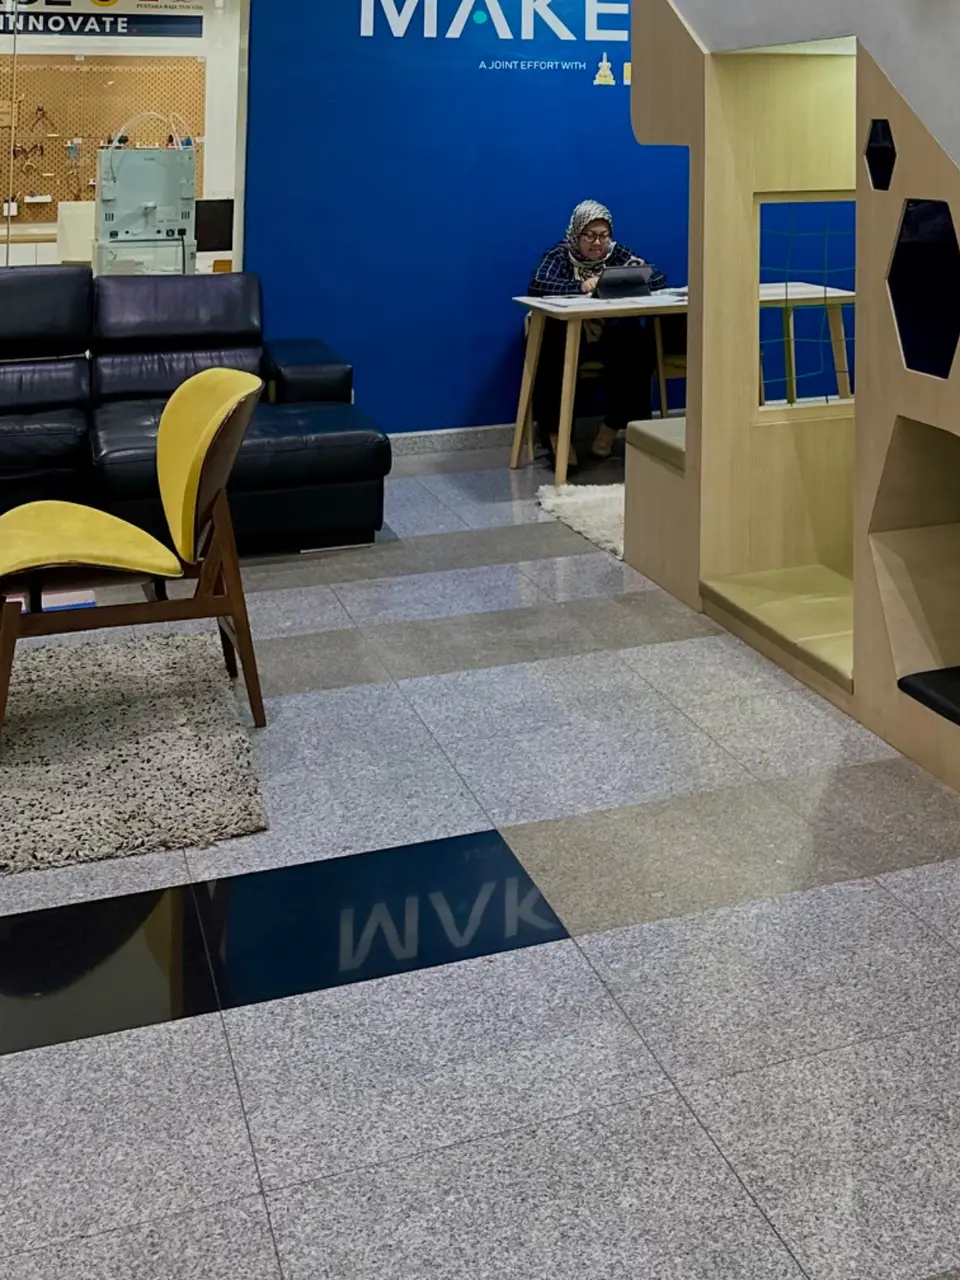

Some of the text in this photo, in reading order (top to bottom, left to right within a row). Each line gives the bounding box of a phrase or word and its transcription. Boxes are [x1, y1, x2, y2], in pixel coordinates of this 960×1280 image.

[478, 60, 587, 70] A JOINT EFFORT WITH
